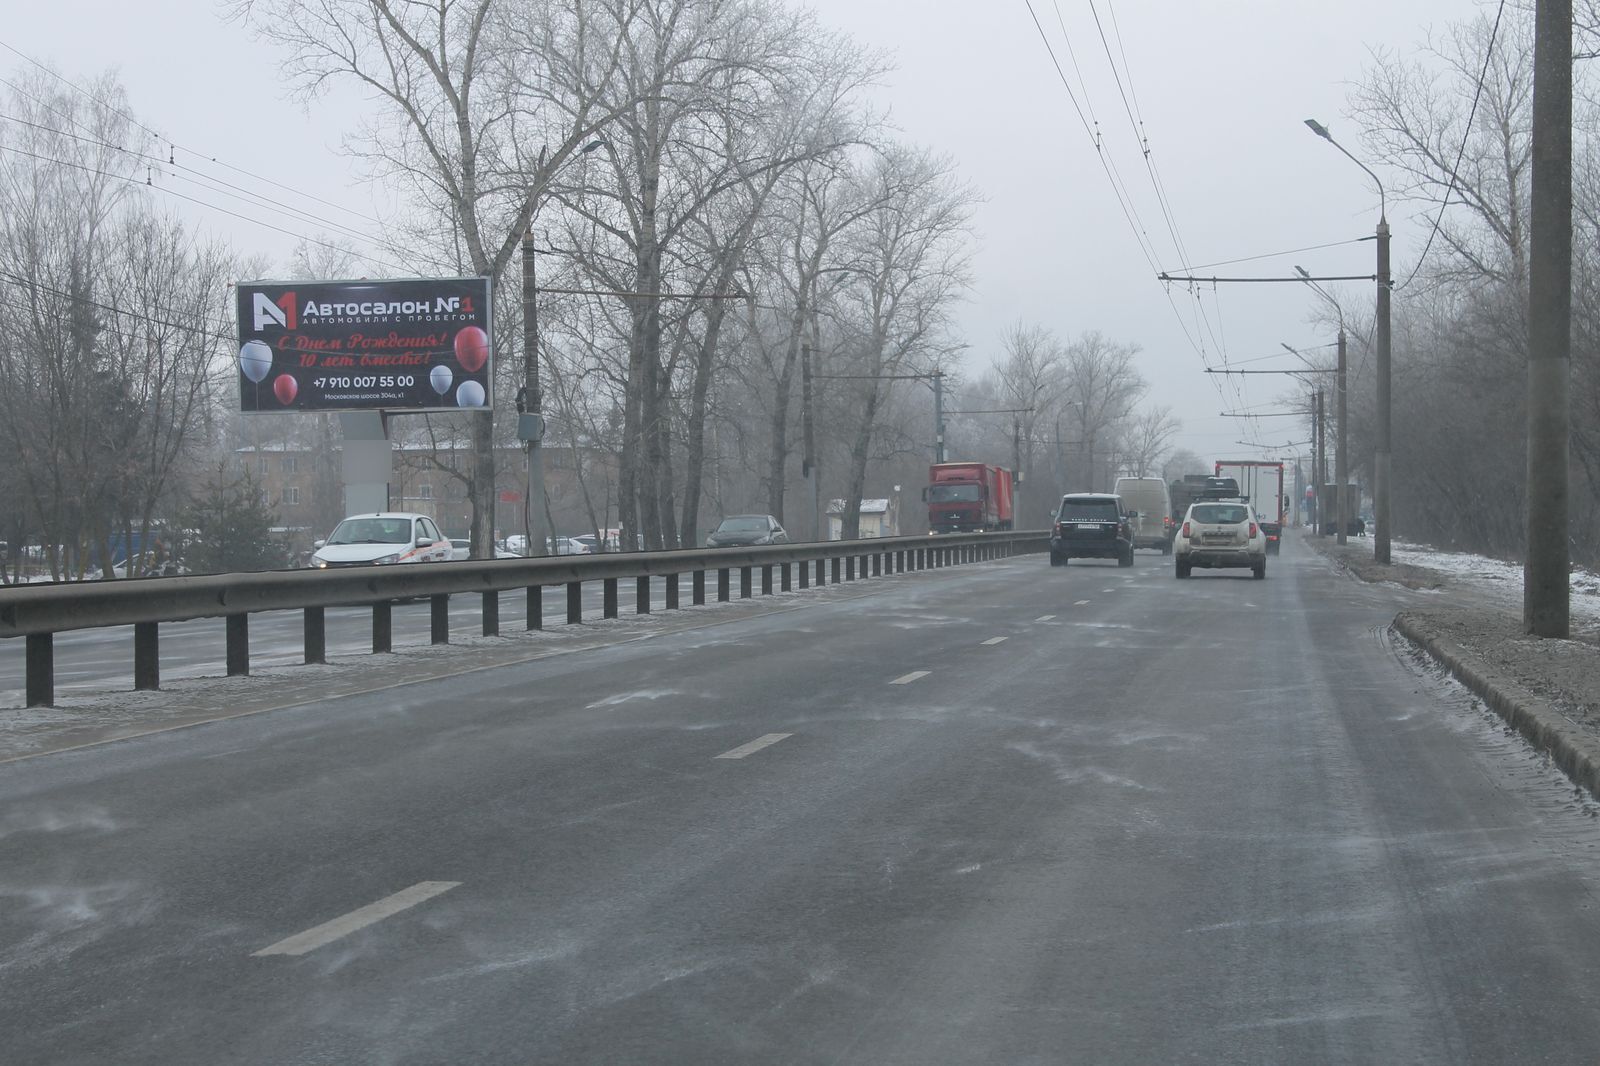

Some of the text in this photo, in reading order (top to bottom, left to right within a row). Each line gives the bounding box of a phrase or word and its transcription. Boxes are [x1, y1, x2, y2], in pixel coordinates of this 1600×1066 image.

[303, 300, 430, 316] Автосалон
[303, 316, 388, 325] АВТОМОБИЛИ
[408, 314, 475, 322] ПРОБЕГОМ
[278, 331, 448, 350] С Днем Рождения!
[299, 351, 432, 367] 10 лет вместе!
[313, 375, 414, 388] +7 910 007 55 00
